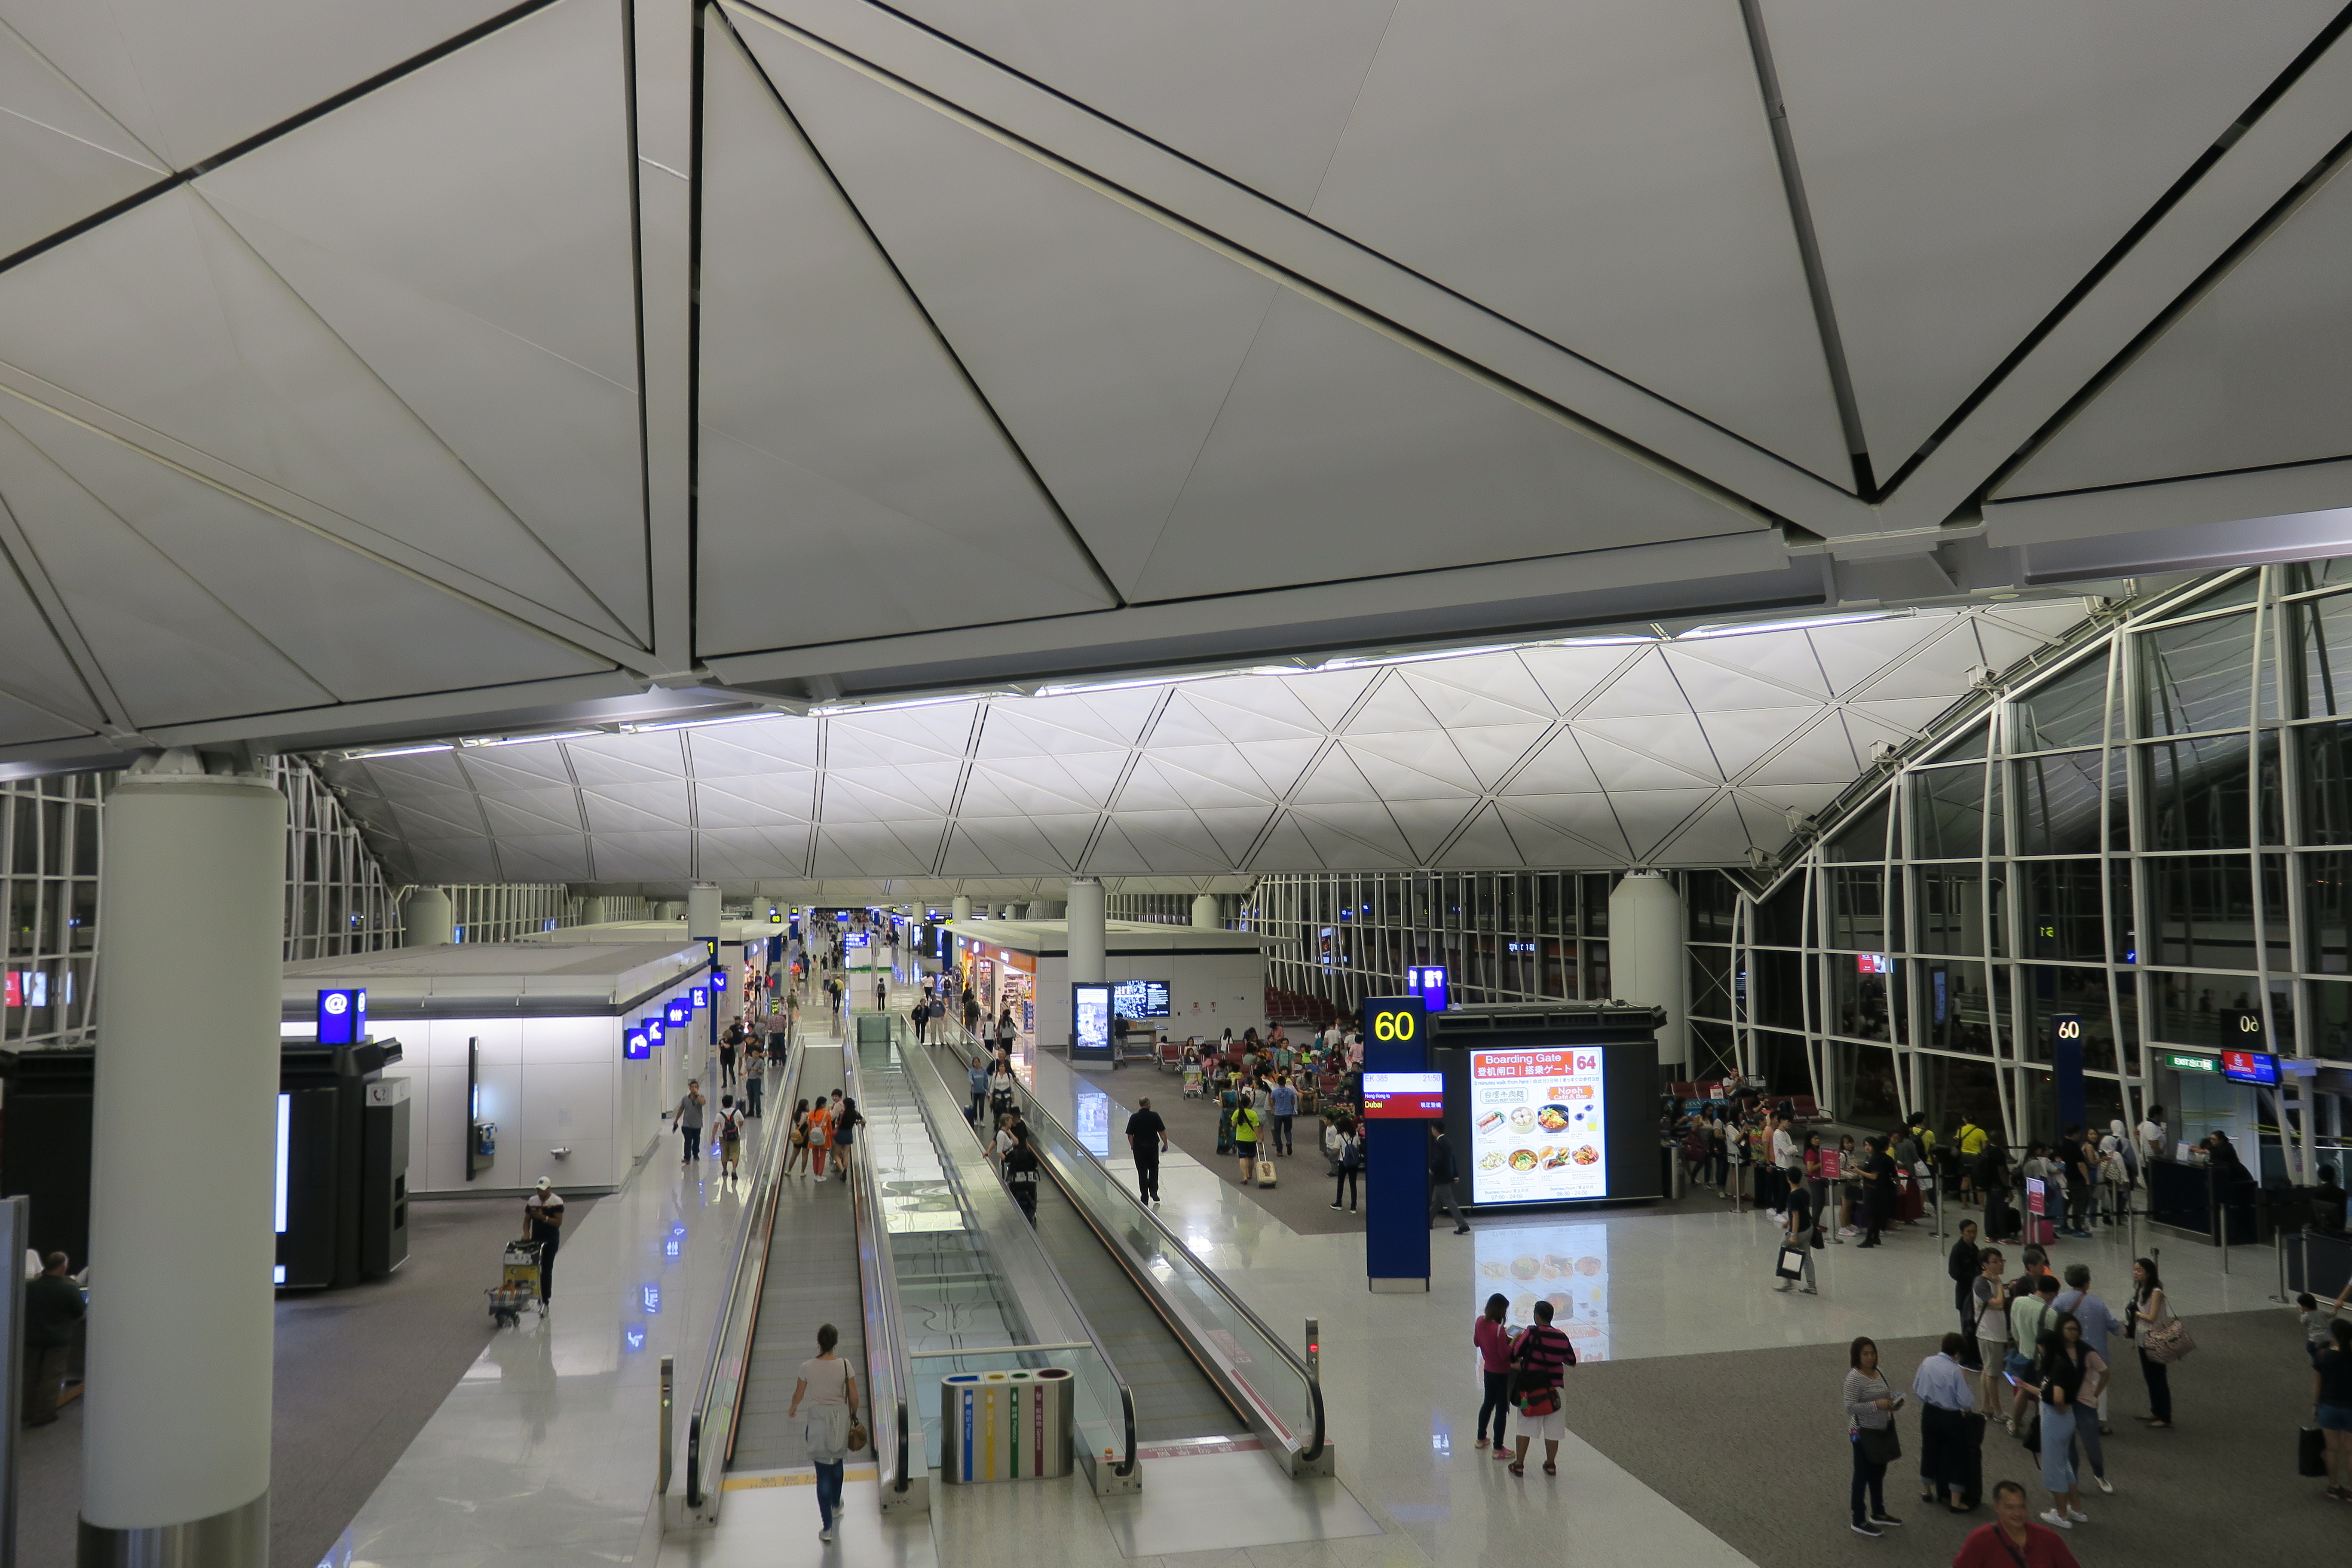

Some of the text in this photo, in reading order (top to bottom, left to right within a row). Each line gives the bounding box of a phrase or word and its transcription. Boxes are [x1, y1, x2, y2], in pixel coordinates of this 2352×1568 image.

[707, 942, 714, 954] 1
[1375, 1011, 1415, 1041] 60
[2058, 1021, 2079, 1039] 60
[1485, 1054, 1562, 1065] Boarding Gate
[1577, 1056, 1596, 1070] 64
[2174, 1057, 2189, 1066] EXIT
[2228, 1064, 2252, 1073] Emirates
[1558, 1087, 1583, 1095] Nosh
